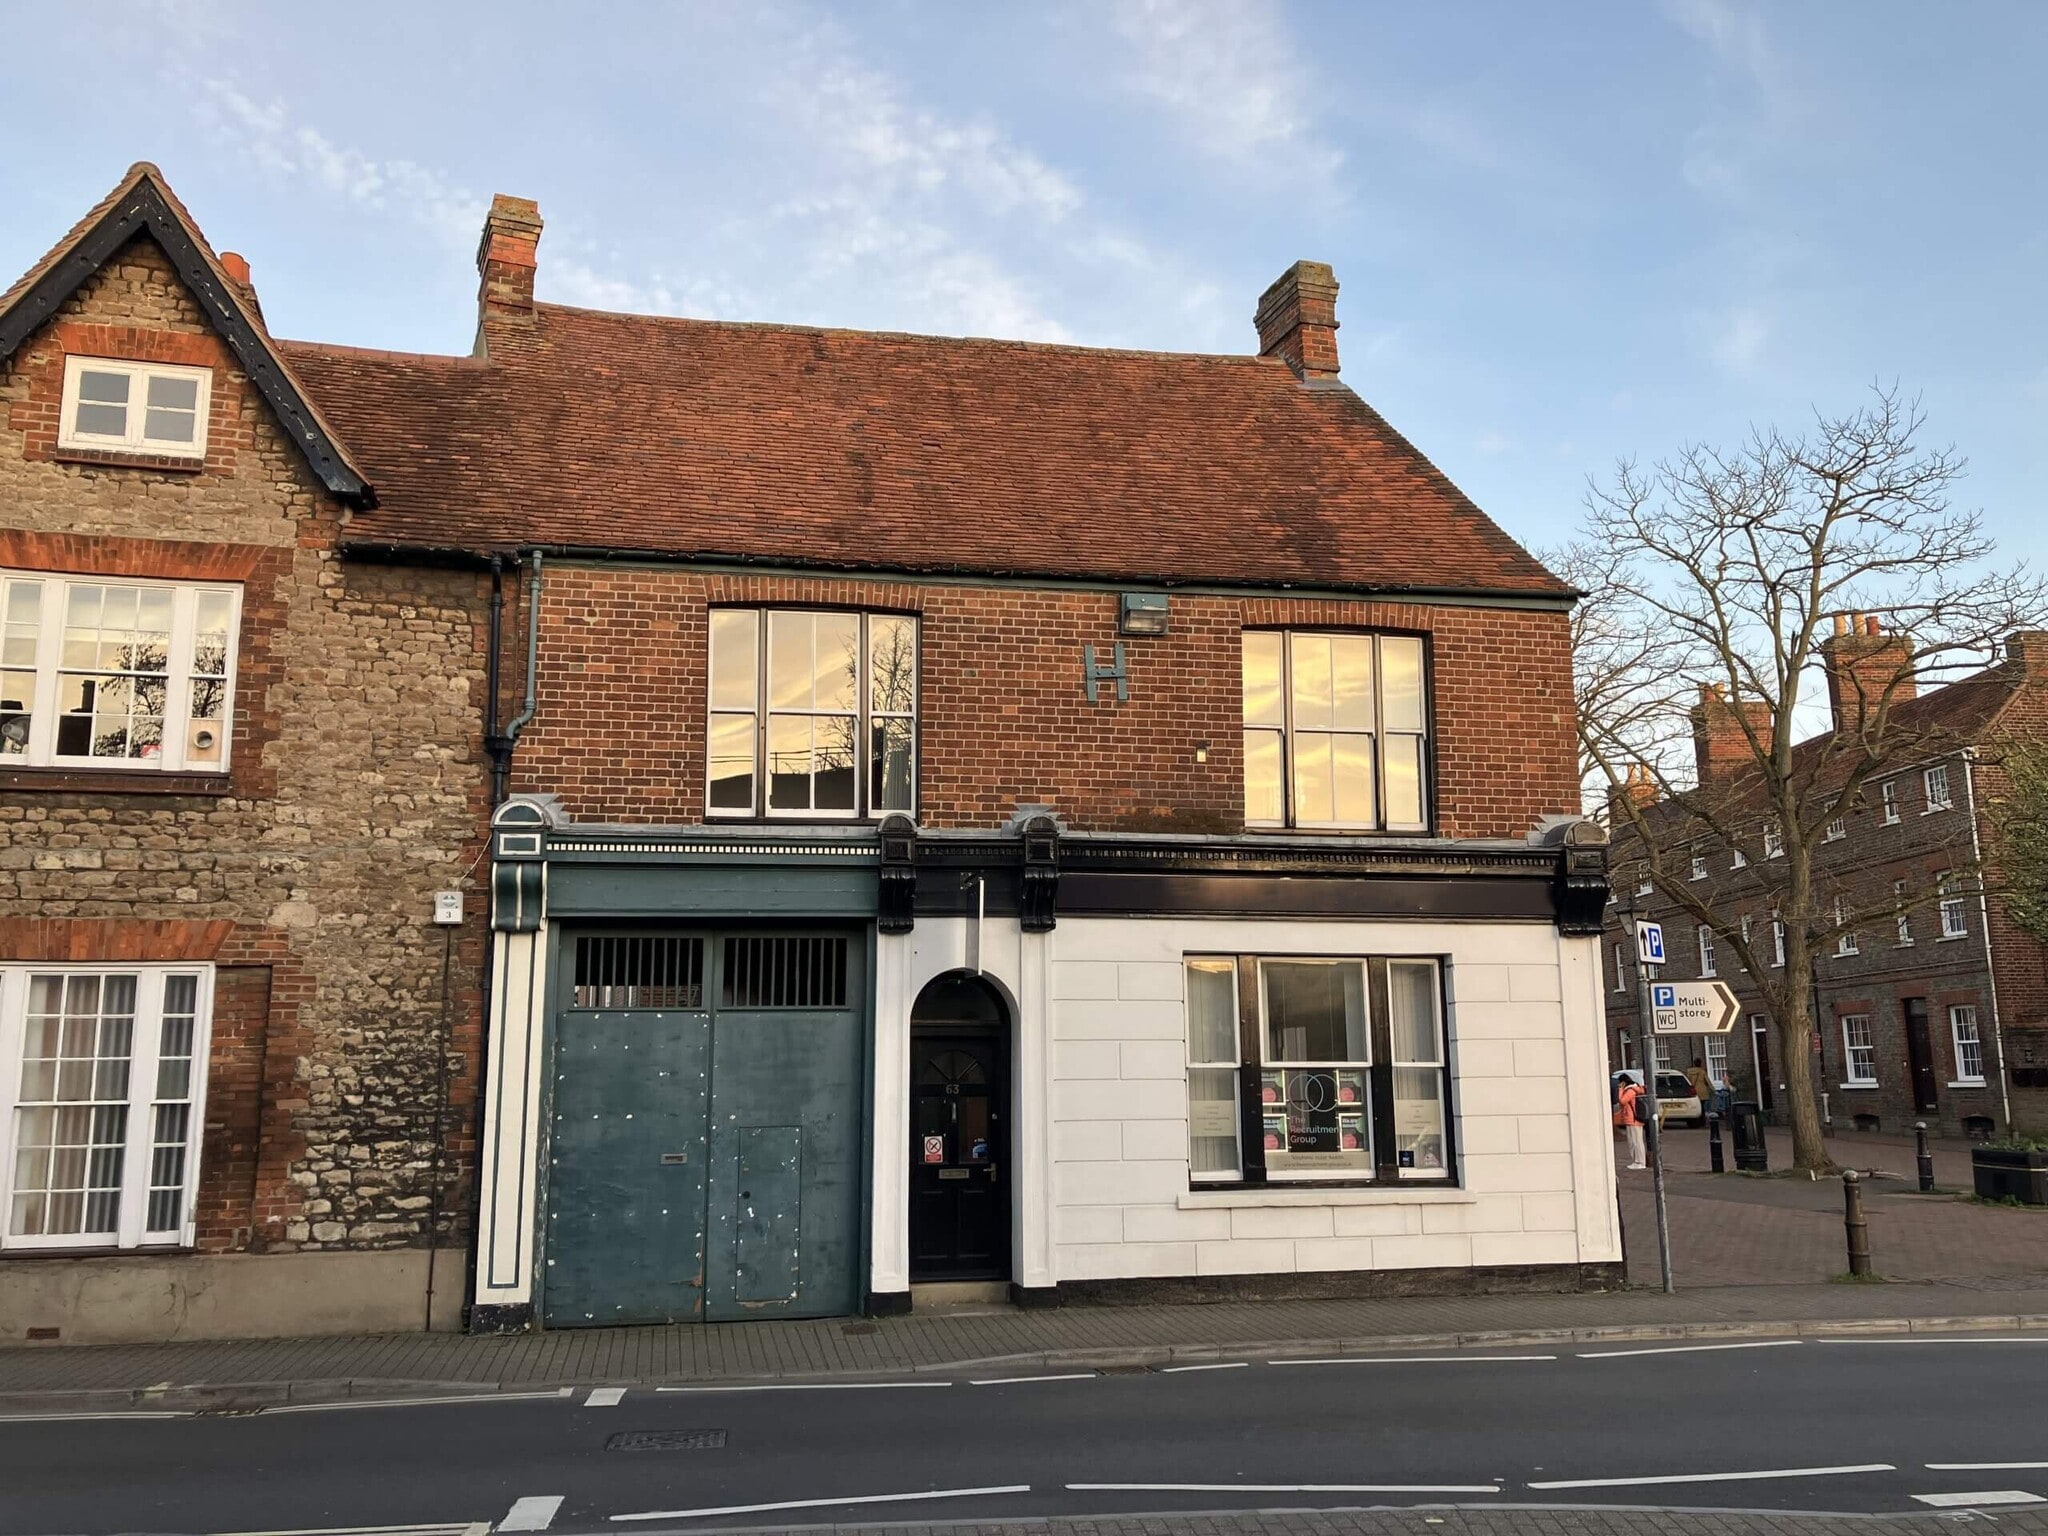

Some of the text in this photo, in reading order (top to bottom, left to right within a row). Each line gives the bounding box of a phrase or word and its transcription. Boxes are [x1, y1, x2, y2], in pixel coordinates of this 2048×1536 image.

[1651, 931, 1660, 955] P
[1659, 988, 1671, 1005] P
[1678, 997, 1709, 1007] Multi-
[1679, 1009, 1712, 1019] storey
[1658, 1014, 1675, 1025] WC
[945, 1084, 960, 1095] 63
[1290, 1116, 1306, 1124] The
[1290, 1125, 1342, 1134] Recruitmen
[1290, 1135, 1318, 1145] Group
